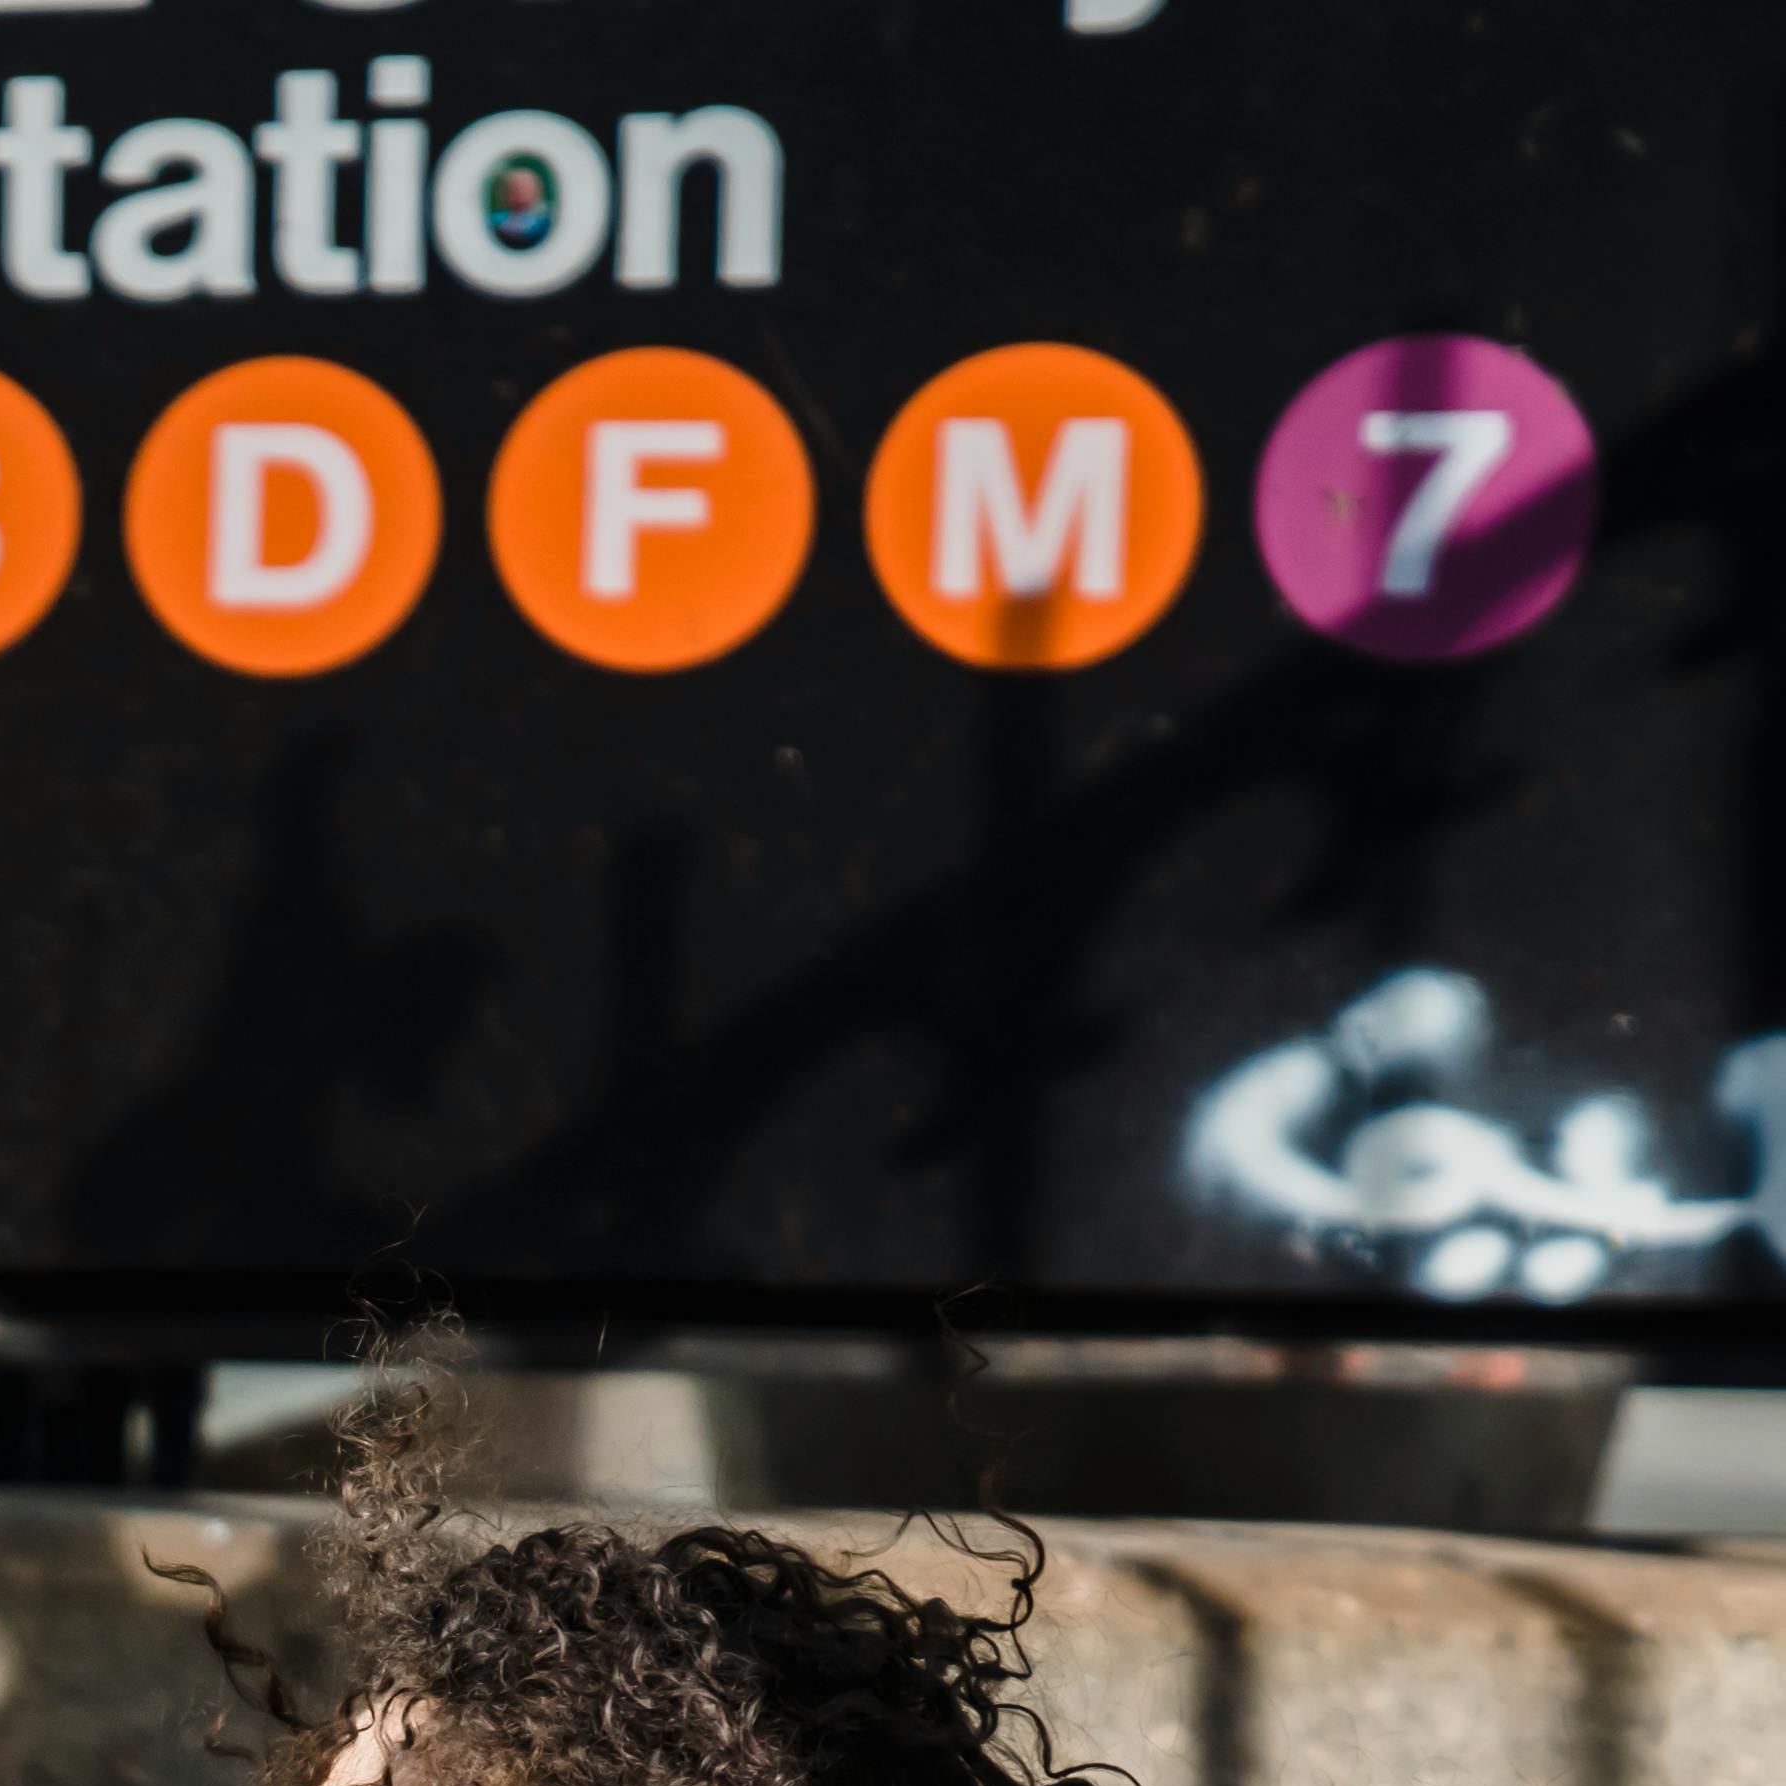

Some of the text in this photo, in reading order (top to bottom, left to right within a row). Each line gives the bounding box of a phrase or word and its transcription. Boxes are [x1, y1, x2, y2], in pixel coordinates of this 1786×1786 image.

[208, 422, 374, 609] D
[582, 419, 725, 600] F
[932, 416, 1128, 602] M
[1356, 406, 1517, 597] 7
